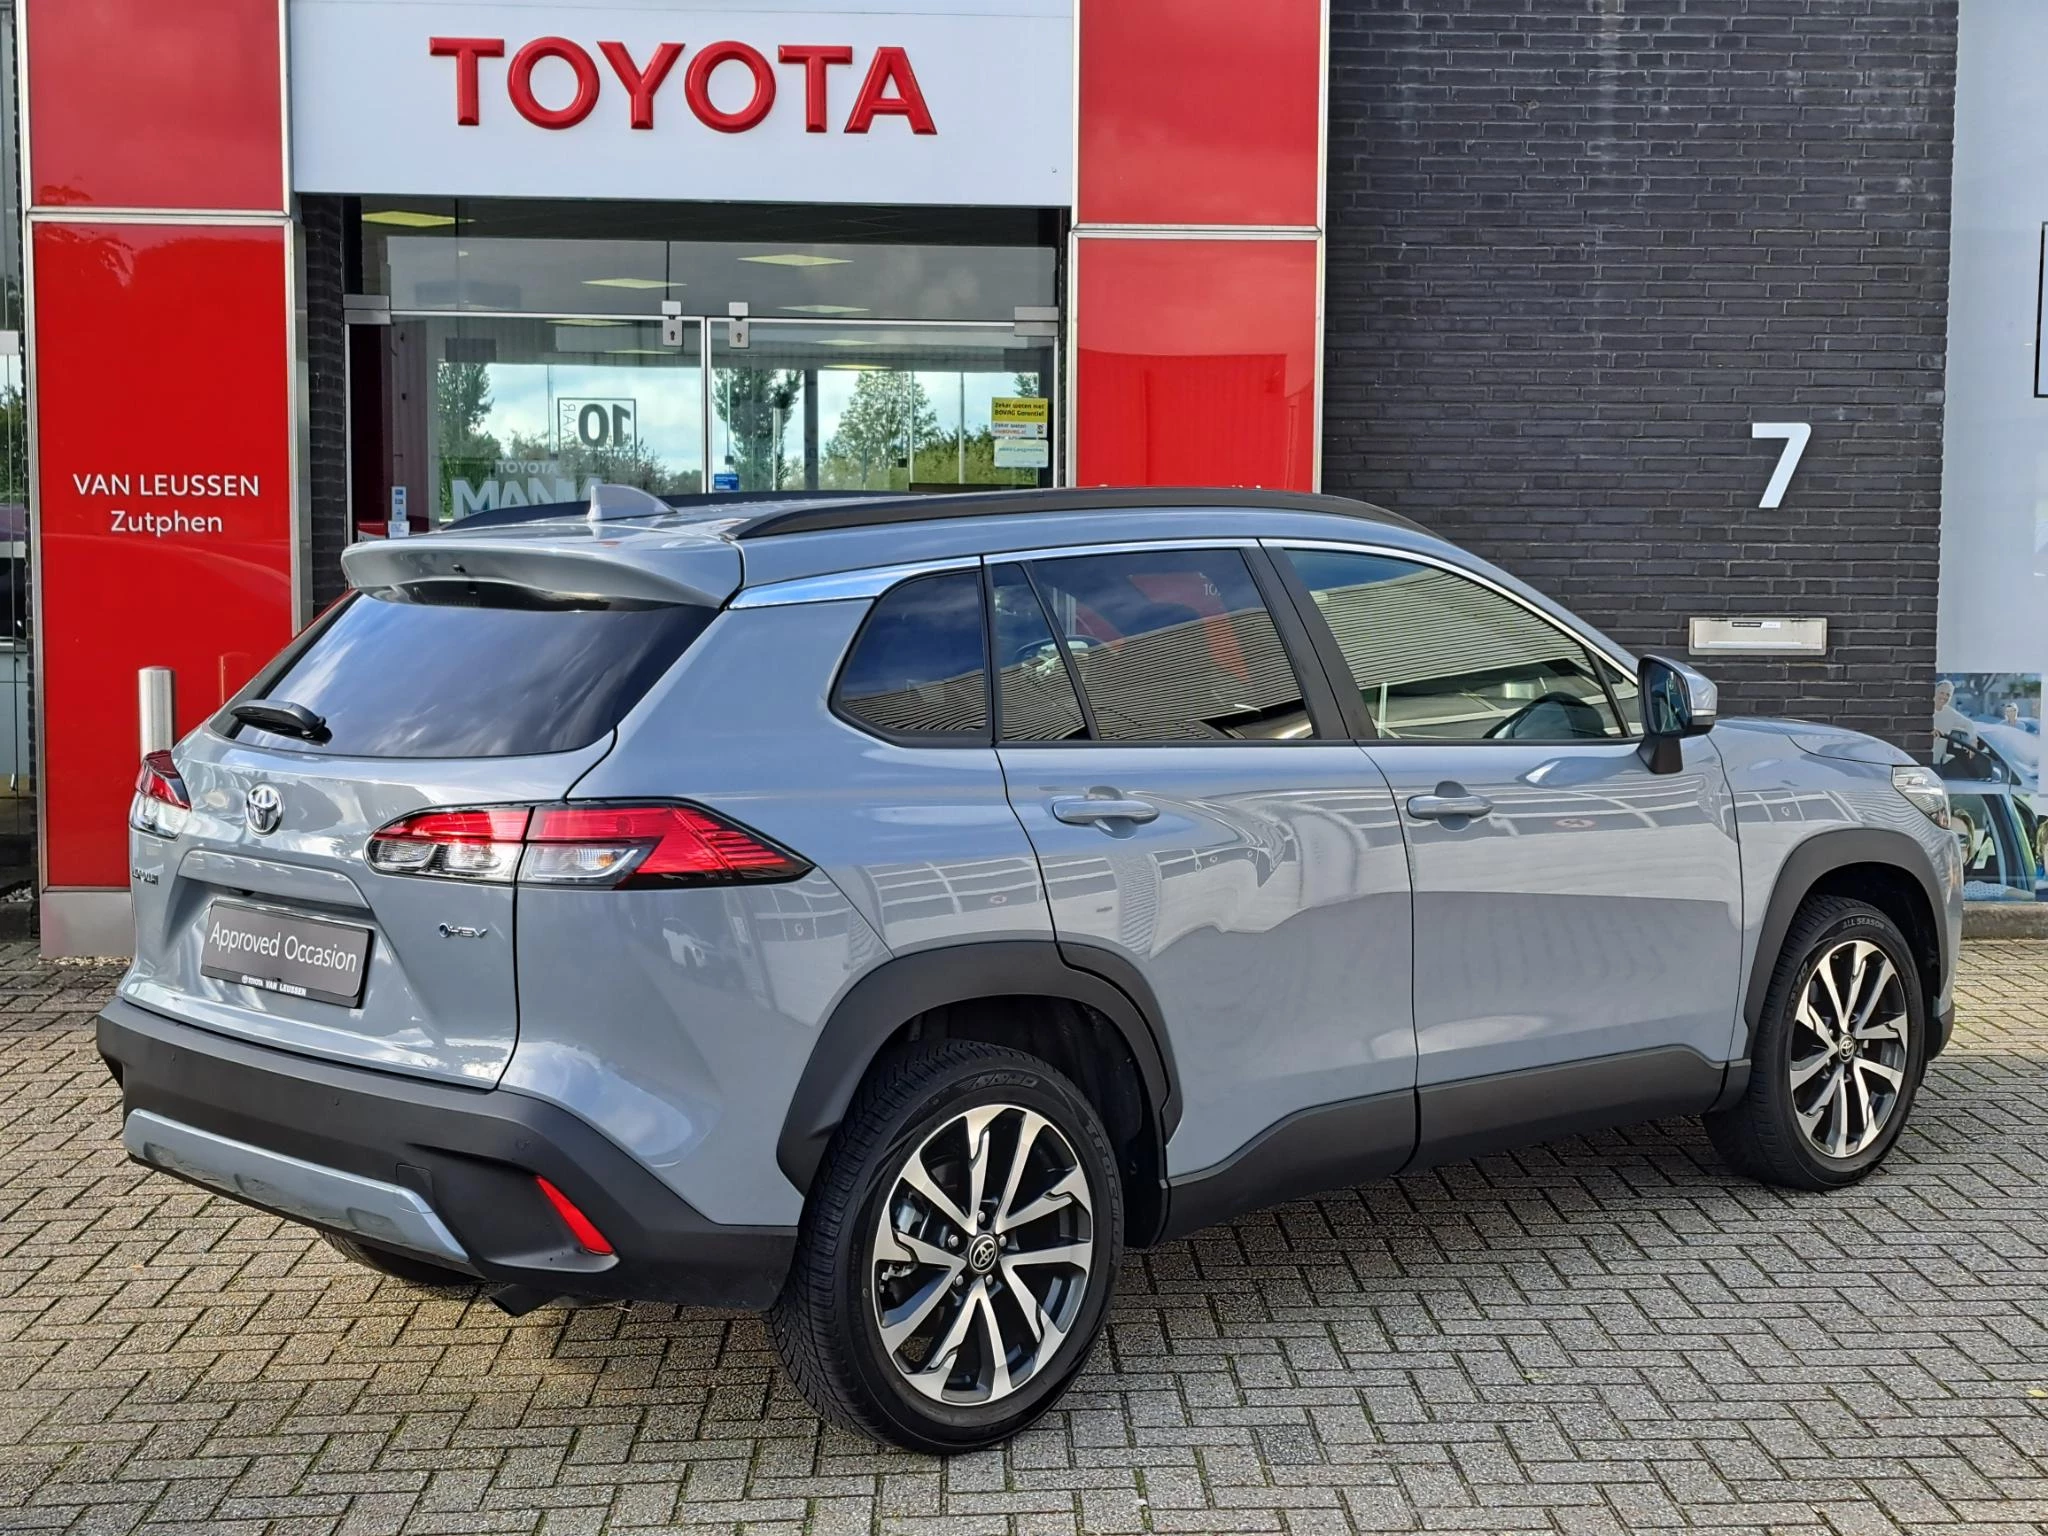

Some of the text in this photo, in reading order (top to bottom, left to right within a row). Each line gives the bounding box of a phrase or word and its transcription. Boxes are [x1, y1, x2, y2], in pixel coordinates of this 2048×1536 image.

[429, 36, 938, 135] TOYOTA
[497, 462, 558, 474] TOYOTA
[1752, 422, 1811, 508] 7
[73, 473, 260, 497] VAN LEUSSEN
[110, 509, 223, 537] Zutphen
[209, 921, 358, 973] Approved Occasion
[265, 980, 278, 990] VAN
[279, 983, 307, 996] LEUSSEN
